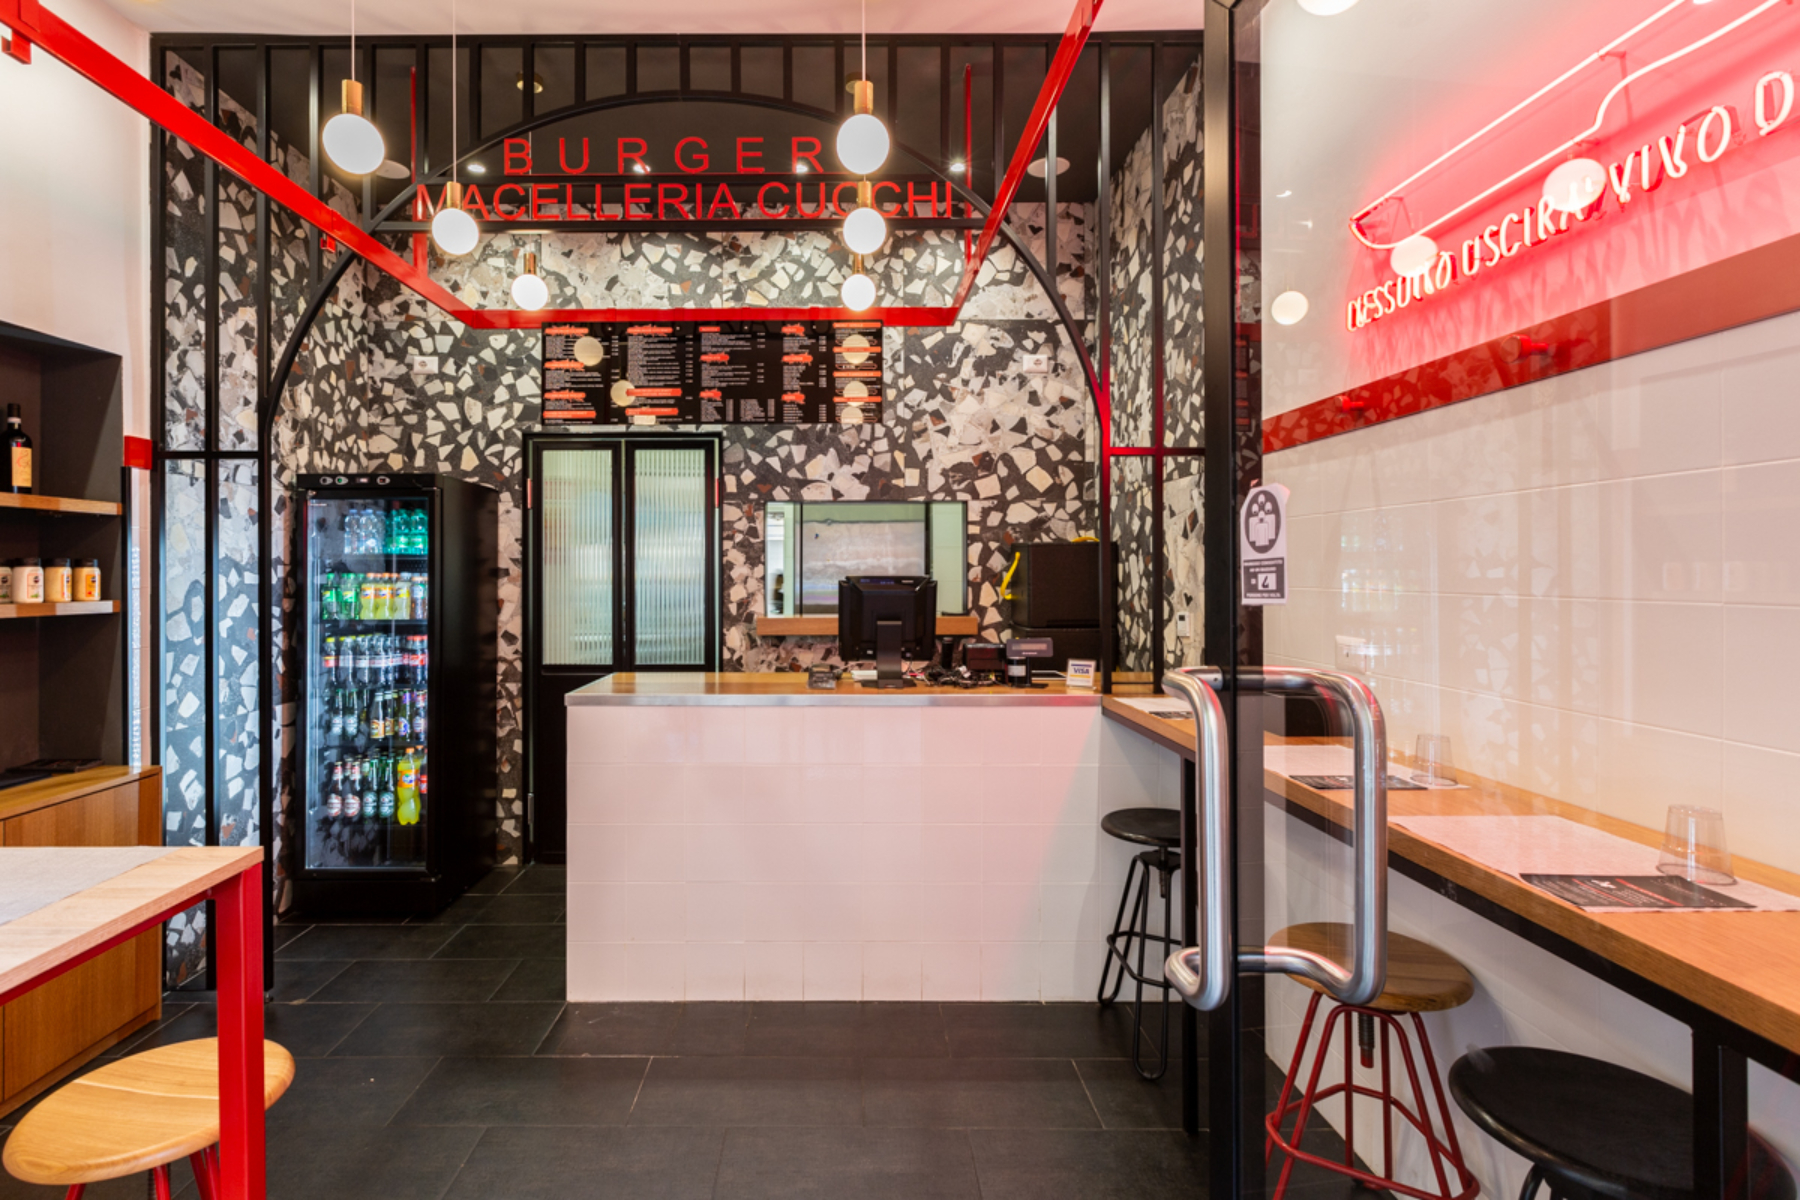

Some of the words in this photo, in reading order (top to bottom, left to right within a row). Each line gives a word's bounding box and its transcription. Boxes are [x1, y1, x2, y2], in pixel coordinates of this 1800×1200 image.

[503, 137, 825, 174] BURGER
[1608, 105, 1732, 204] VIVO
[416, 183, 741, 220] MACELLERIA
[757, 181, 952, 219] CUCCHI
[1074, 667, 1090, 675] VISA
